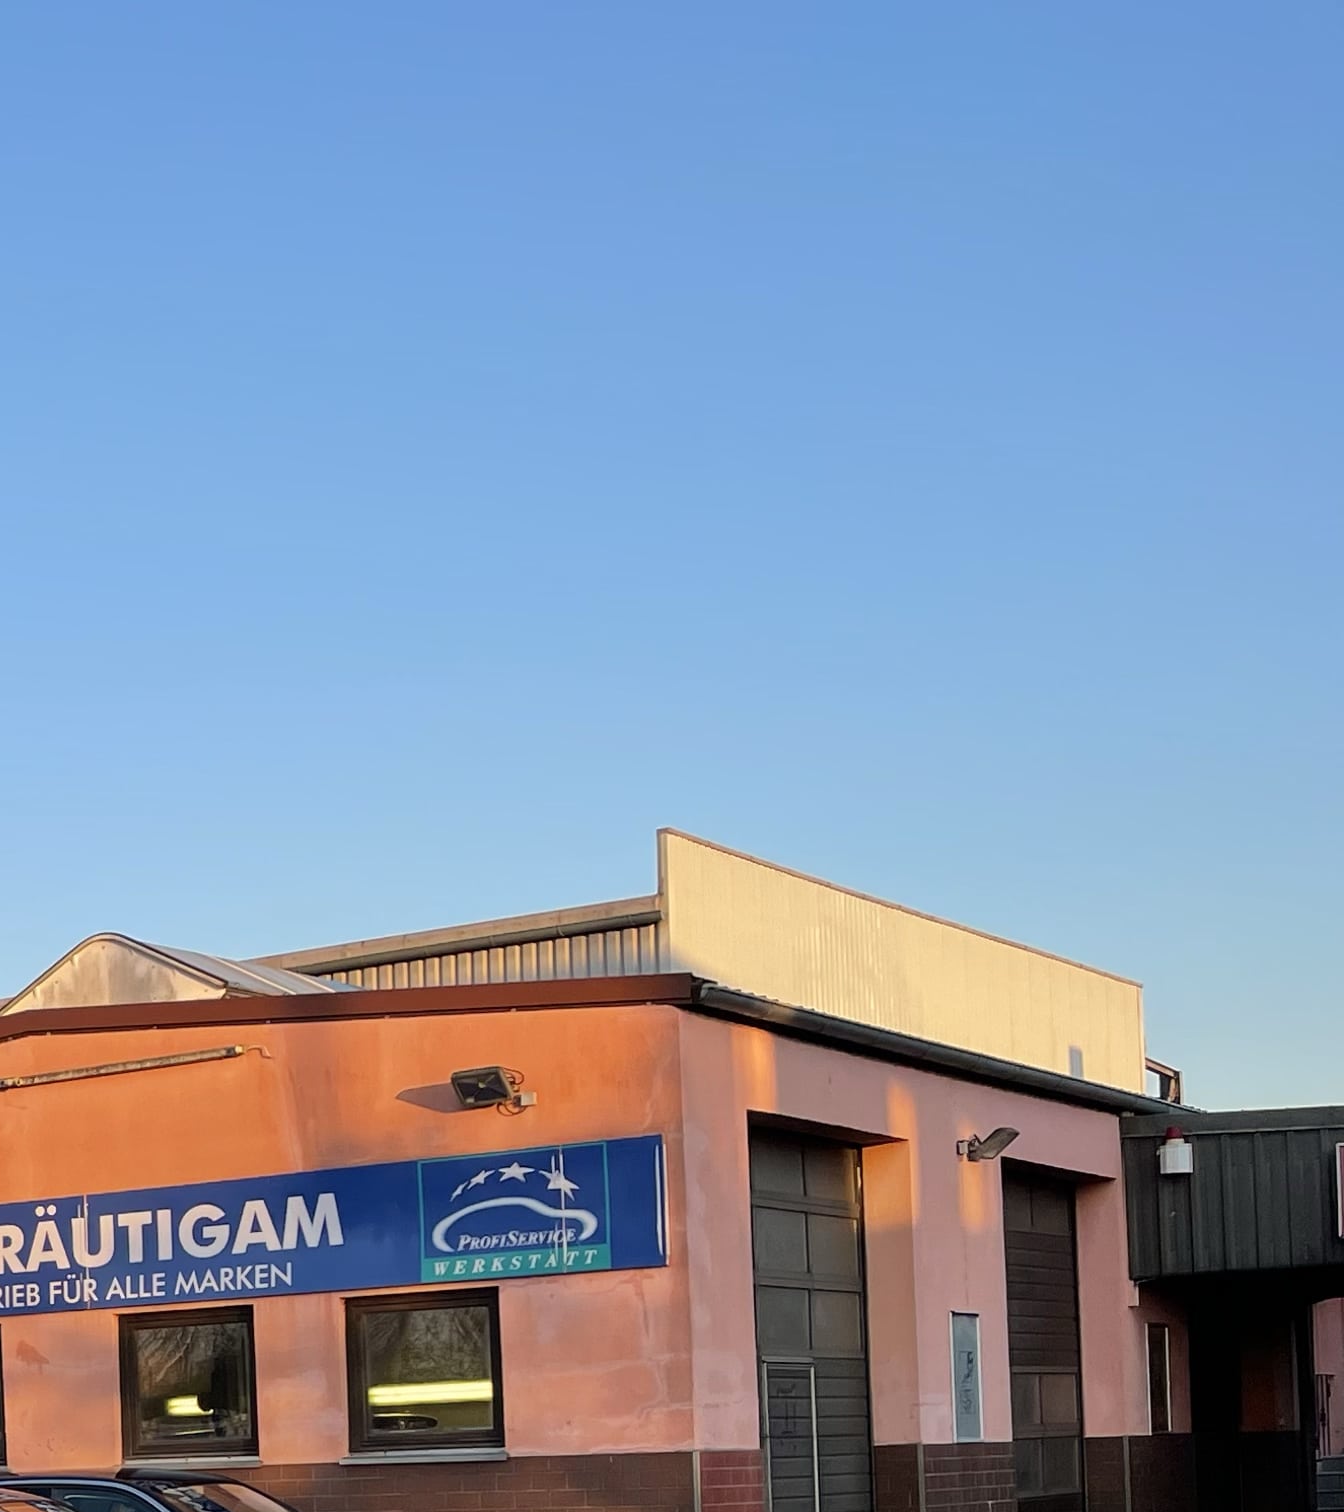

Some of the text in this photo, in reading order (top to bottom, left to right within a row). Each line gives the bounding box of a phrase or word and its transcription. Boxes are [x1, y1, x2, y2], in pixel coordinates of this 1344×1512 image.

[433, 1248, 599, 1276] WERKSTATT
[48, 1273, 99, 1304] FÜR
[105, 1271, 166, 1300] ALLE
[174, 1261, 293, 1296] MARKEN
